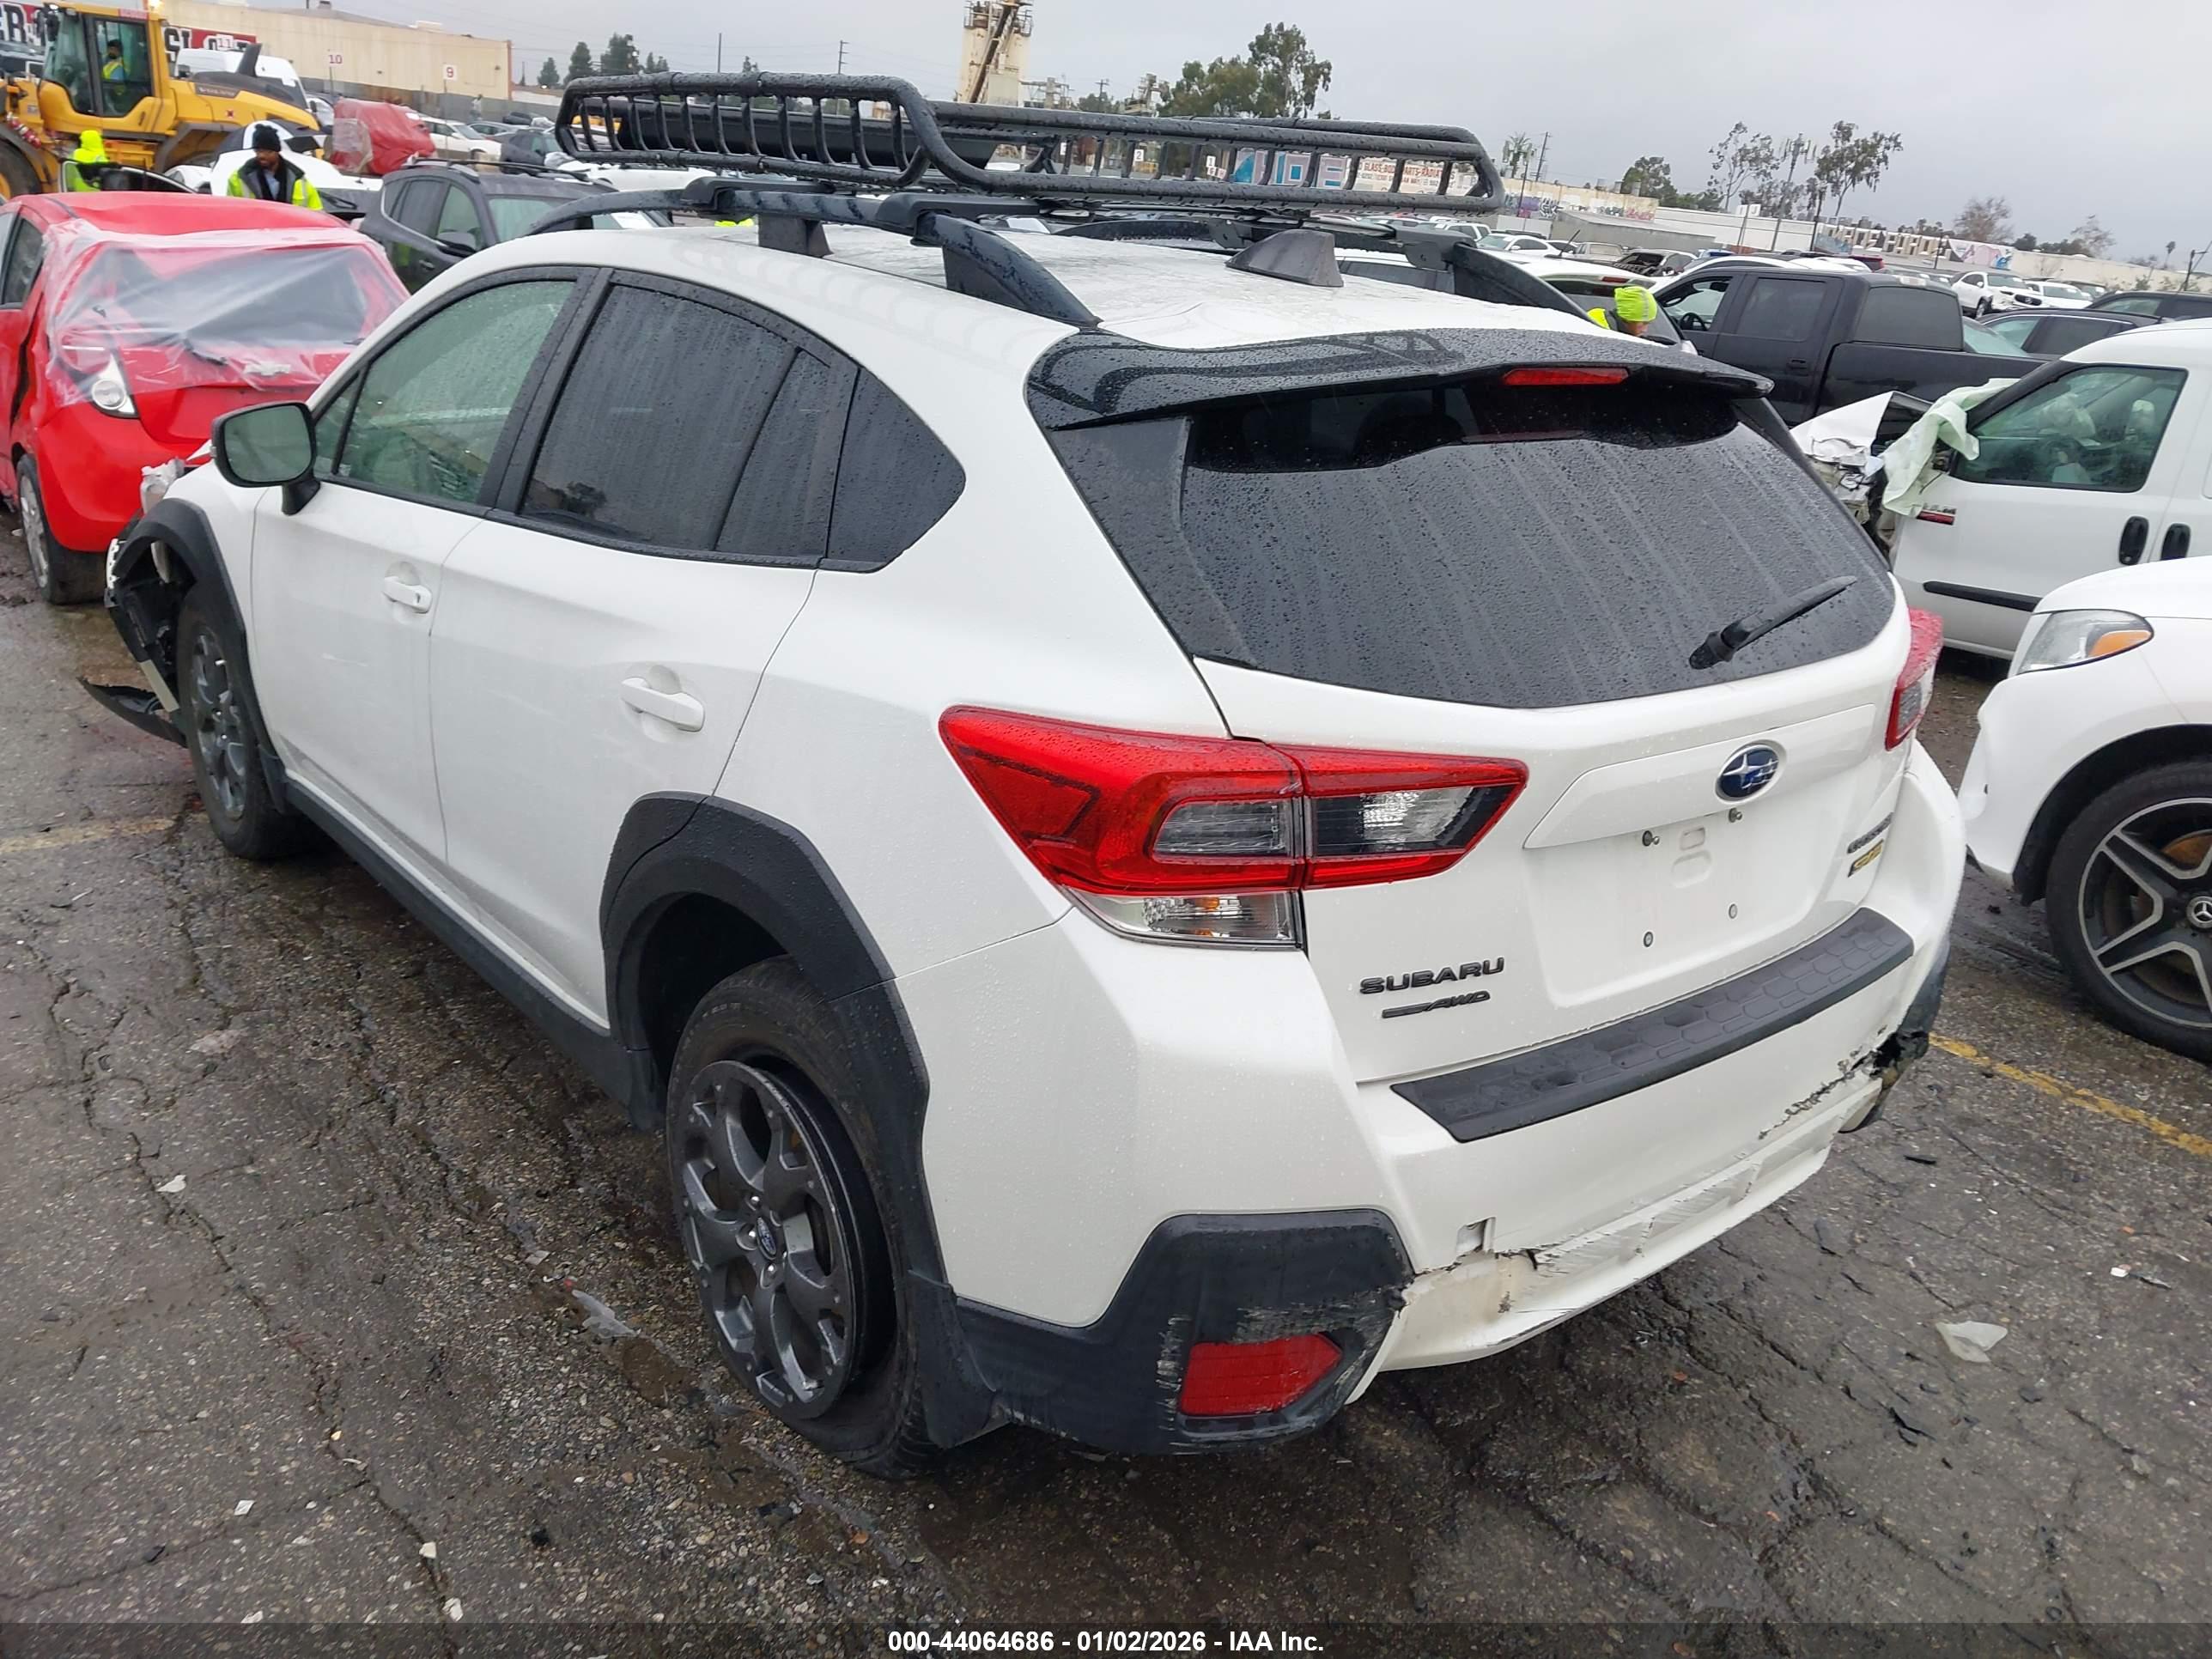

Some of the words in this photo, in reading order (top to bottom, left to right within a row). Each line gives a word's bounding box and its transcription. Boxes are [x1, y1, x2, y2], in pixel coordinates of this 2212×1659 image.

[329, 54, 343, 64] 10
[446, 66, 454, 78] 9
[1136, 150, 1143, 161] 2
[1359, 957, 1505, 994] SUBARU
[1425, 990, 1491, 1012] AWD
